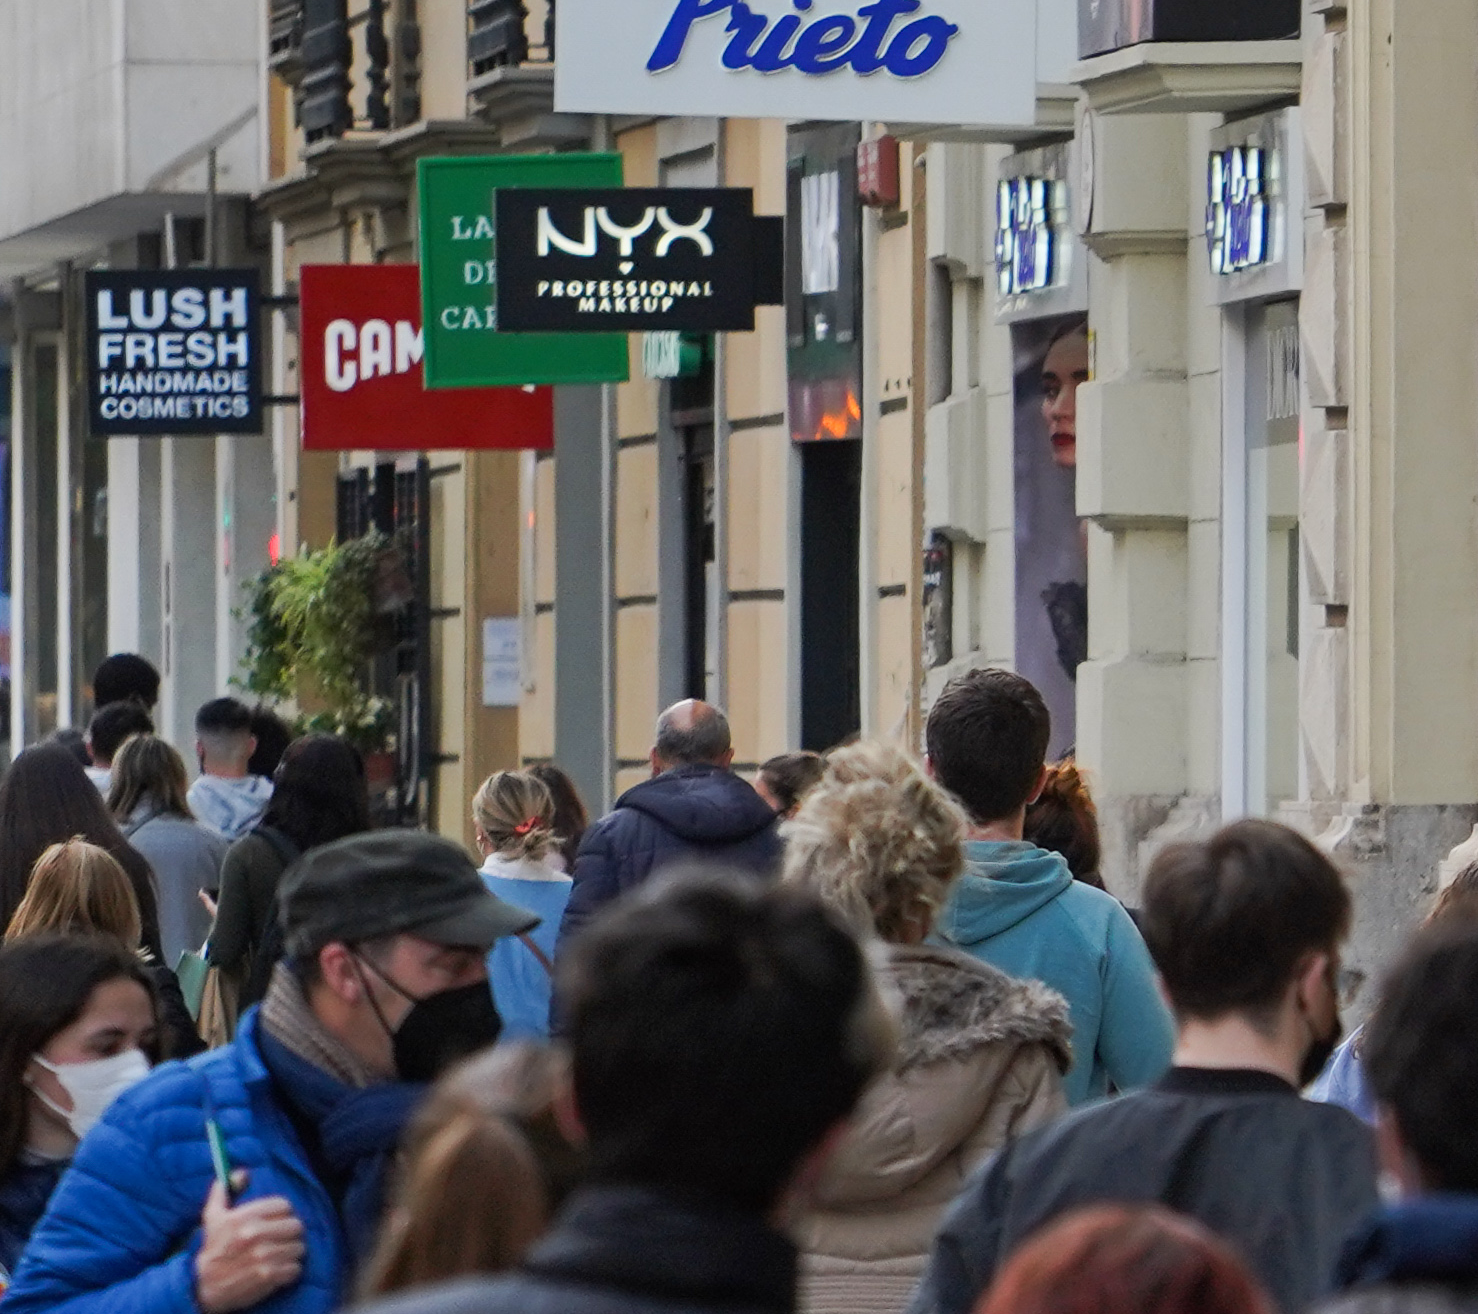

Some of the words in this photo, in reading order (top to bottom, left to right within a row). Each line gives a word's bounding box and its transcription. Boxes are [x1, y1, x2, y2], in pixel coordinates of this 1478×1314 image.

[537, 206, 714, 257] NYX
[537, 280, 714, 298] PROFESSIONAL
[98, 288, 248, 329] LUSH
[577, 296, 674, 313] MAKEUP
[99, 332, 248, 369] FRESH
[100, 371, 248, 394] HANDMADE
[101, 395, 249, 420] COSMETICS
